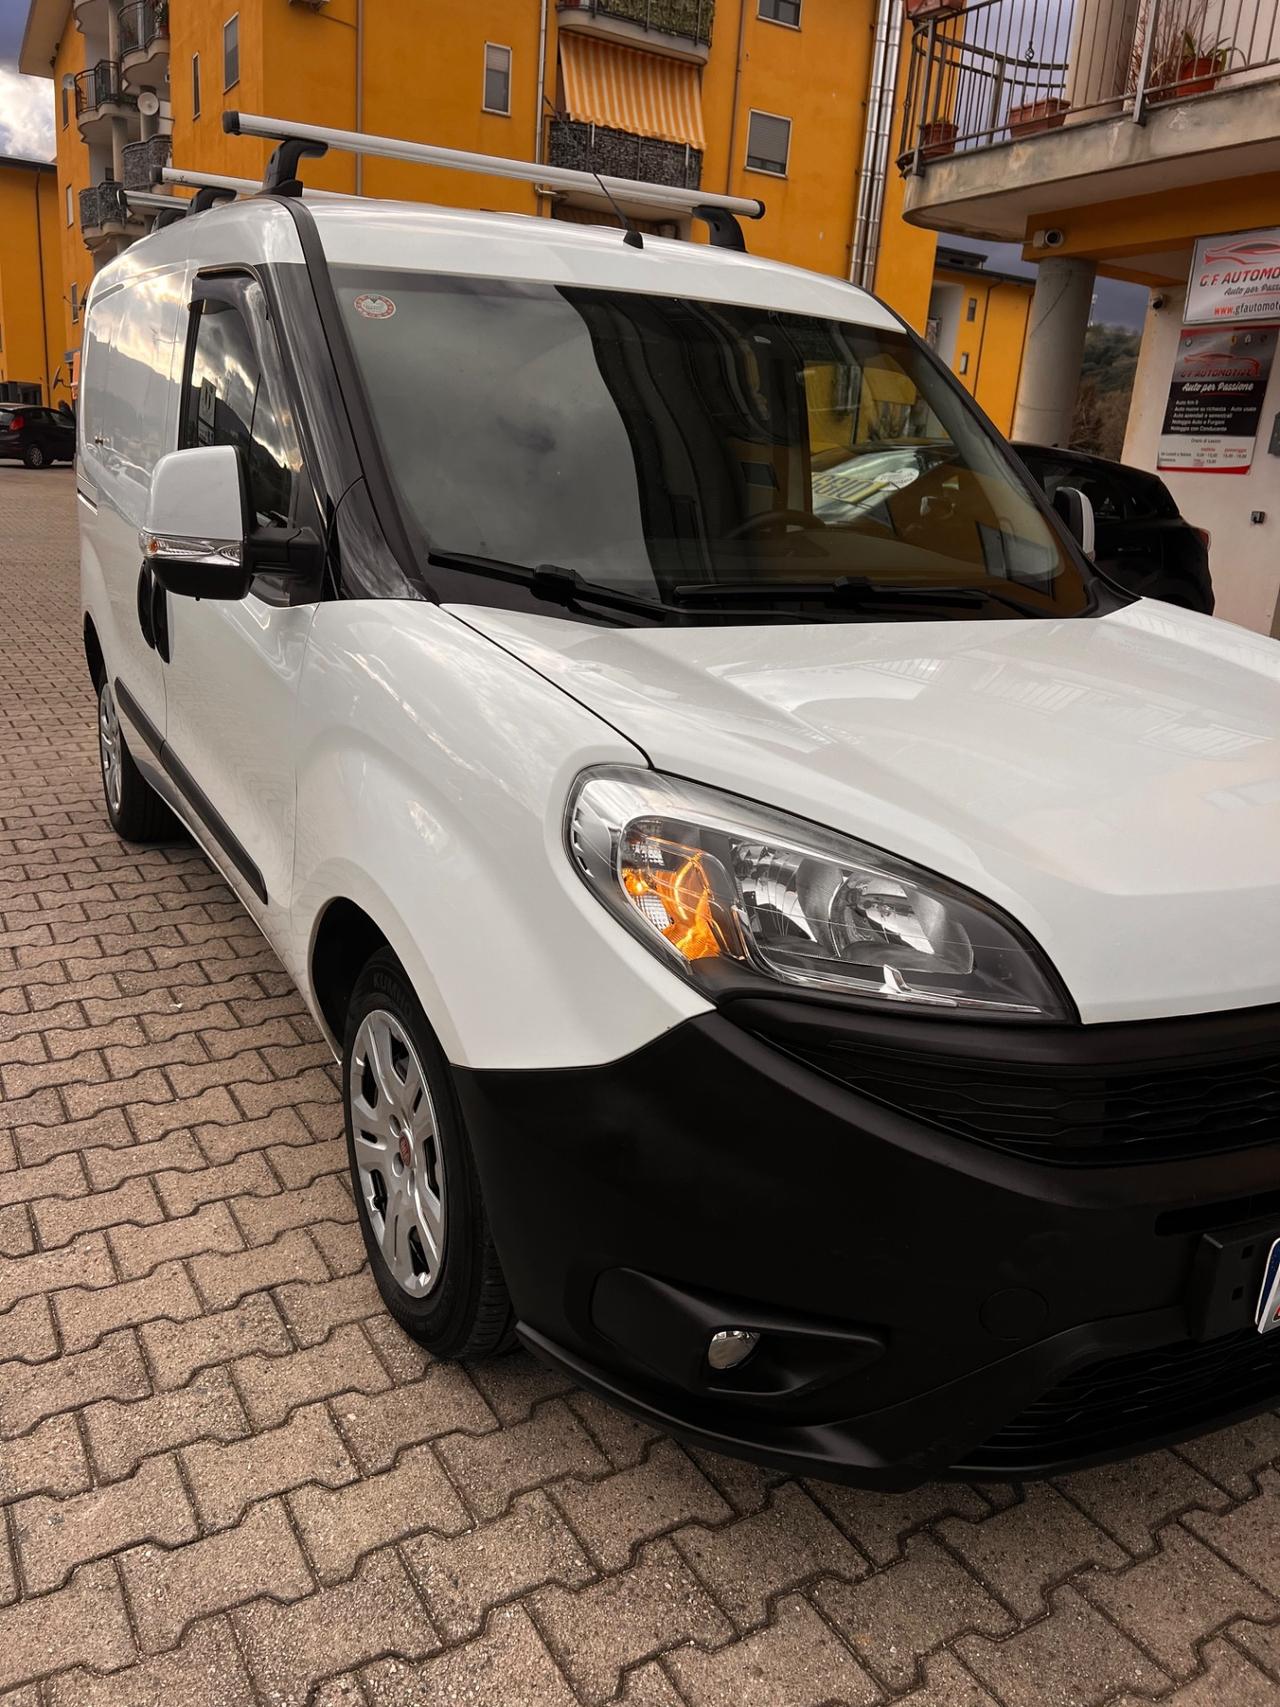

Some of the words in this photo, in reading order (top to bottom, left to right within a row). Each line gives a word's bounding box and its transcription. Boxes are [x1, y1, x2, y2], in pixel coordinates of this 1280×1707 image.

[1224, 286, 1243, 295] Auto
[1243, 285, 1259, 296] per
[1182, 382, 1201, 392] Auto
[1200, 383, 1216, 393] per
[1217, 381, 1254, 392] Passione
